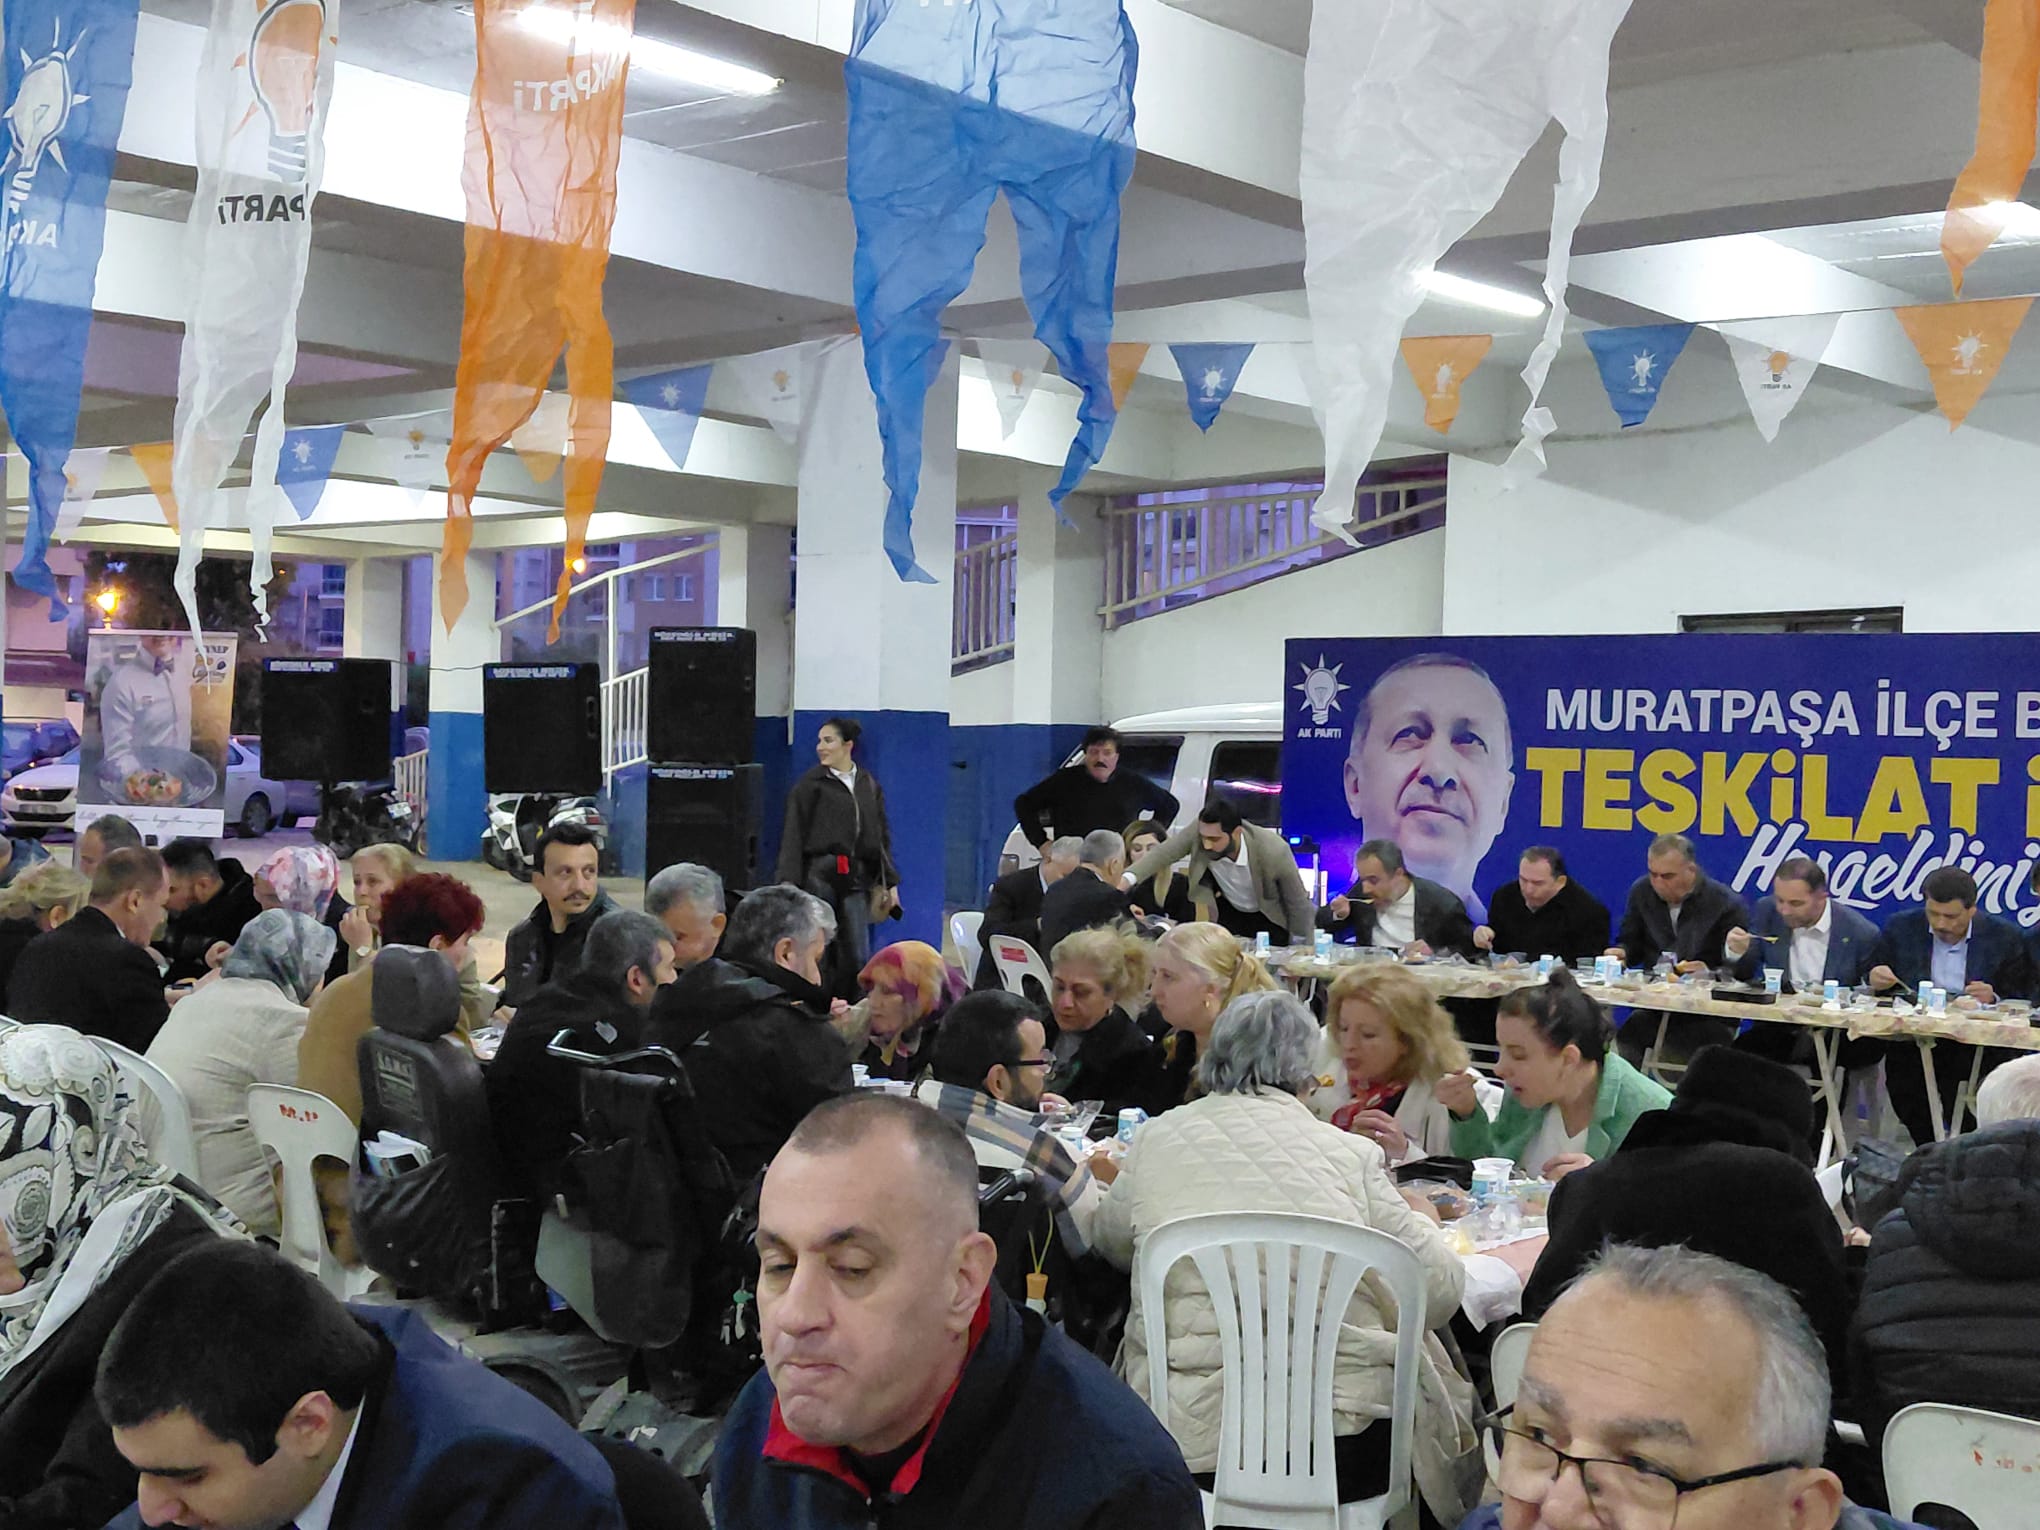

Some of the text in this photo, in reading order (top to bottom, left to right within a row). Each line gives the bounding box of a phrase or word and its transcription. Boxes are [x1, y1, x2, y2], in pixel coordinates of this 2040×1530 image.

[1297, 727, 1313, 739] AK
[1546, 688, 1861, 748] MURATPAŞA
[1876, 678, 2000, 752] İLÇE
